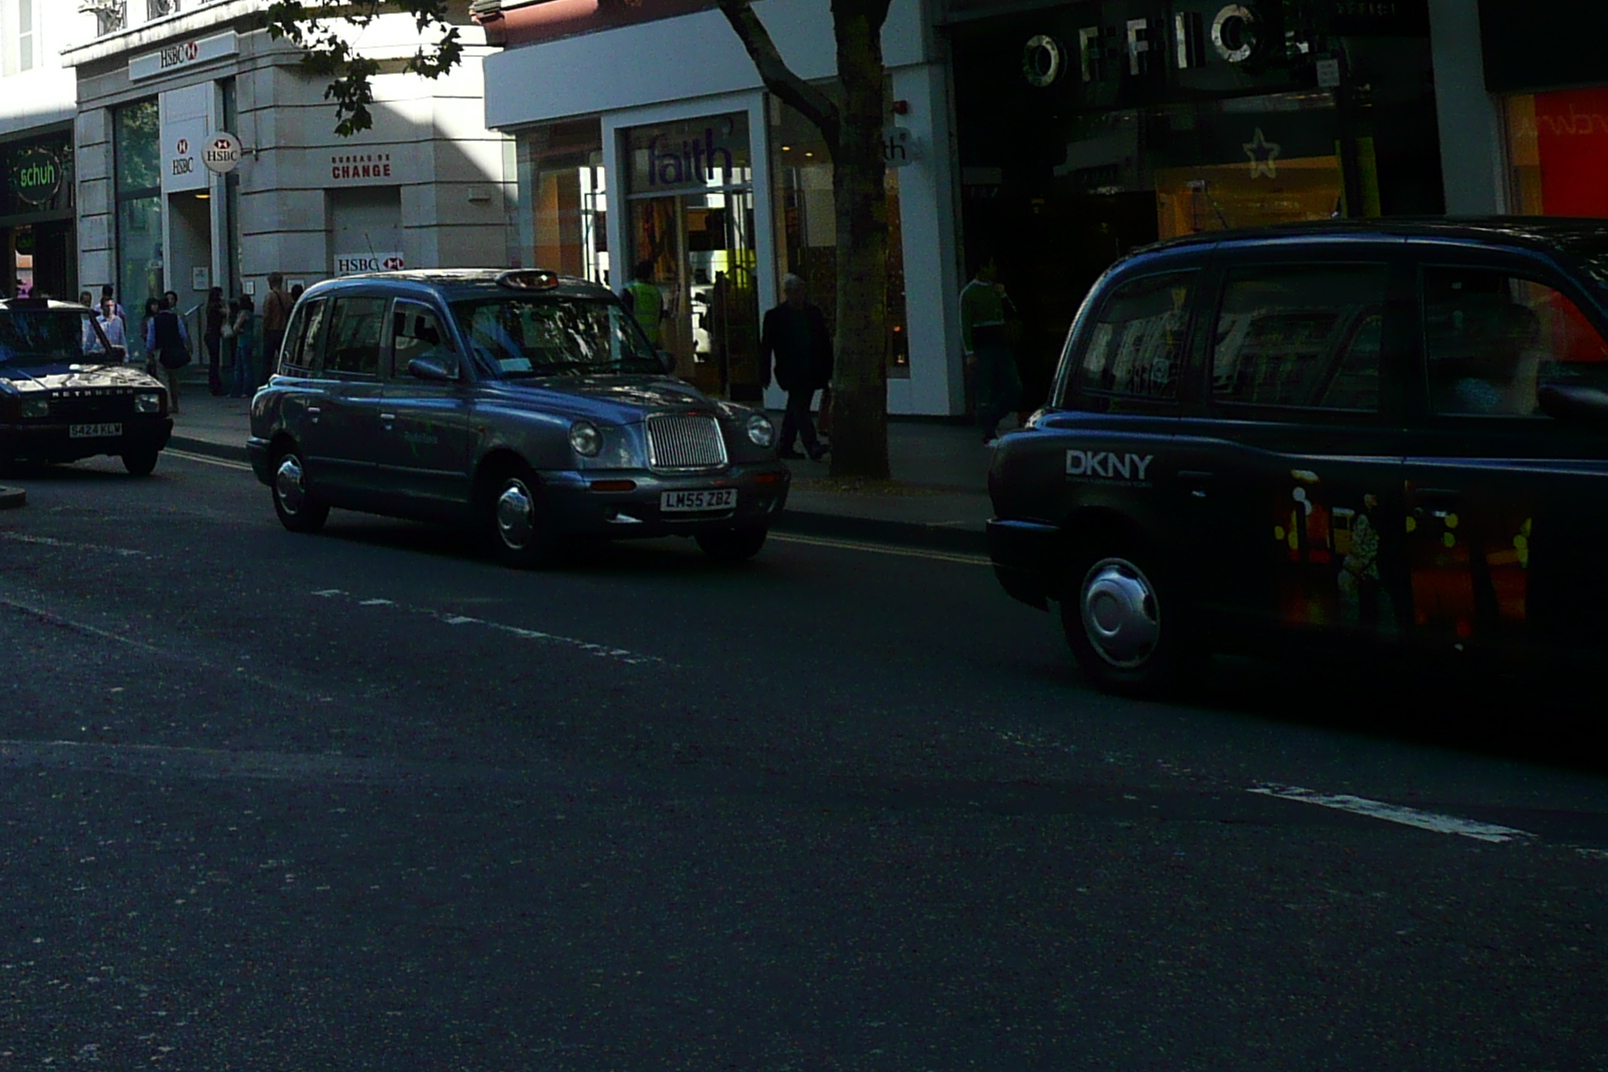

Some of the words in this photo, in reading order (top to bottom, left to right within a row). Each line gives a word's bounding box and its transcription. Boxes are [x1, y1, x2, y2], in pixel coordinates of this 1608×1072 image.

[160, 44, 185, 68] HSBC
[207, 150, 238, 162] HSBC
[332, 154, 372, 164] BUREAU
[377, 153, 390, 161] DE
[648, 127, 733, 186] faith
[20, 161, 55, 188] schuh
[172, 157, 194, 175] HSBC
[332, 164, 391, 179] CHANGE
[338, 258, 379, 272] HSBC
[1065, 449, 1155, 481] DKNY
[666, 492, 704, 508] LM55
